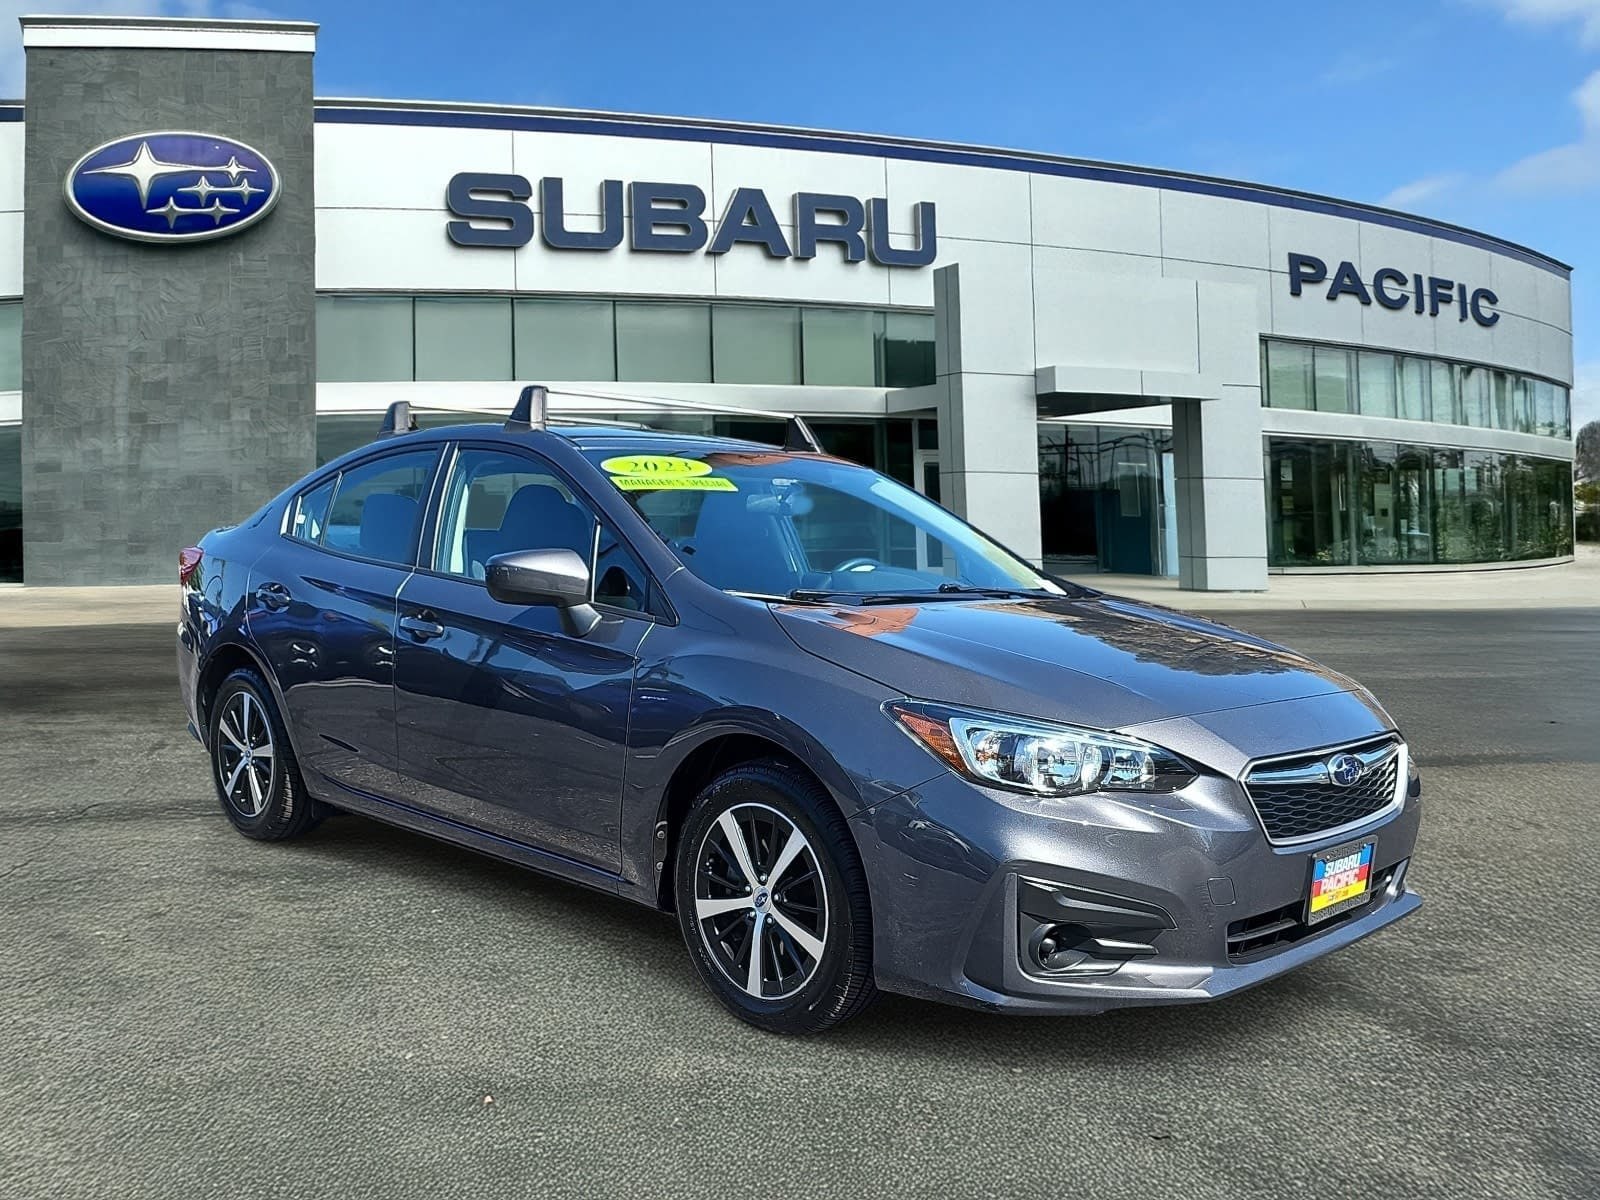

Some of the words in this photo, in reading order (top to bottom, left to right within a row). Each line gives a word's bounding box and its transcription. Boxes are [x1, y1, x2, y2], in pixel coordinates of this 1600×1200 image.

[446, 171, 937, 267] SUBARU
[1288, 252, 1500, 327] PACIFIC
[629, 460, 692, 473] 2023
[1324, 851, 1362, 878] SUBARU
[1320, 869, 1361, 894] PACIFIC
